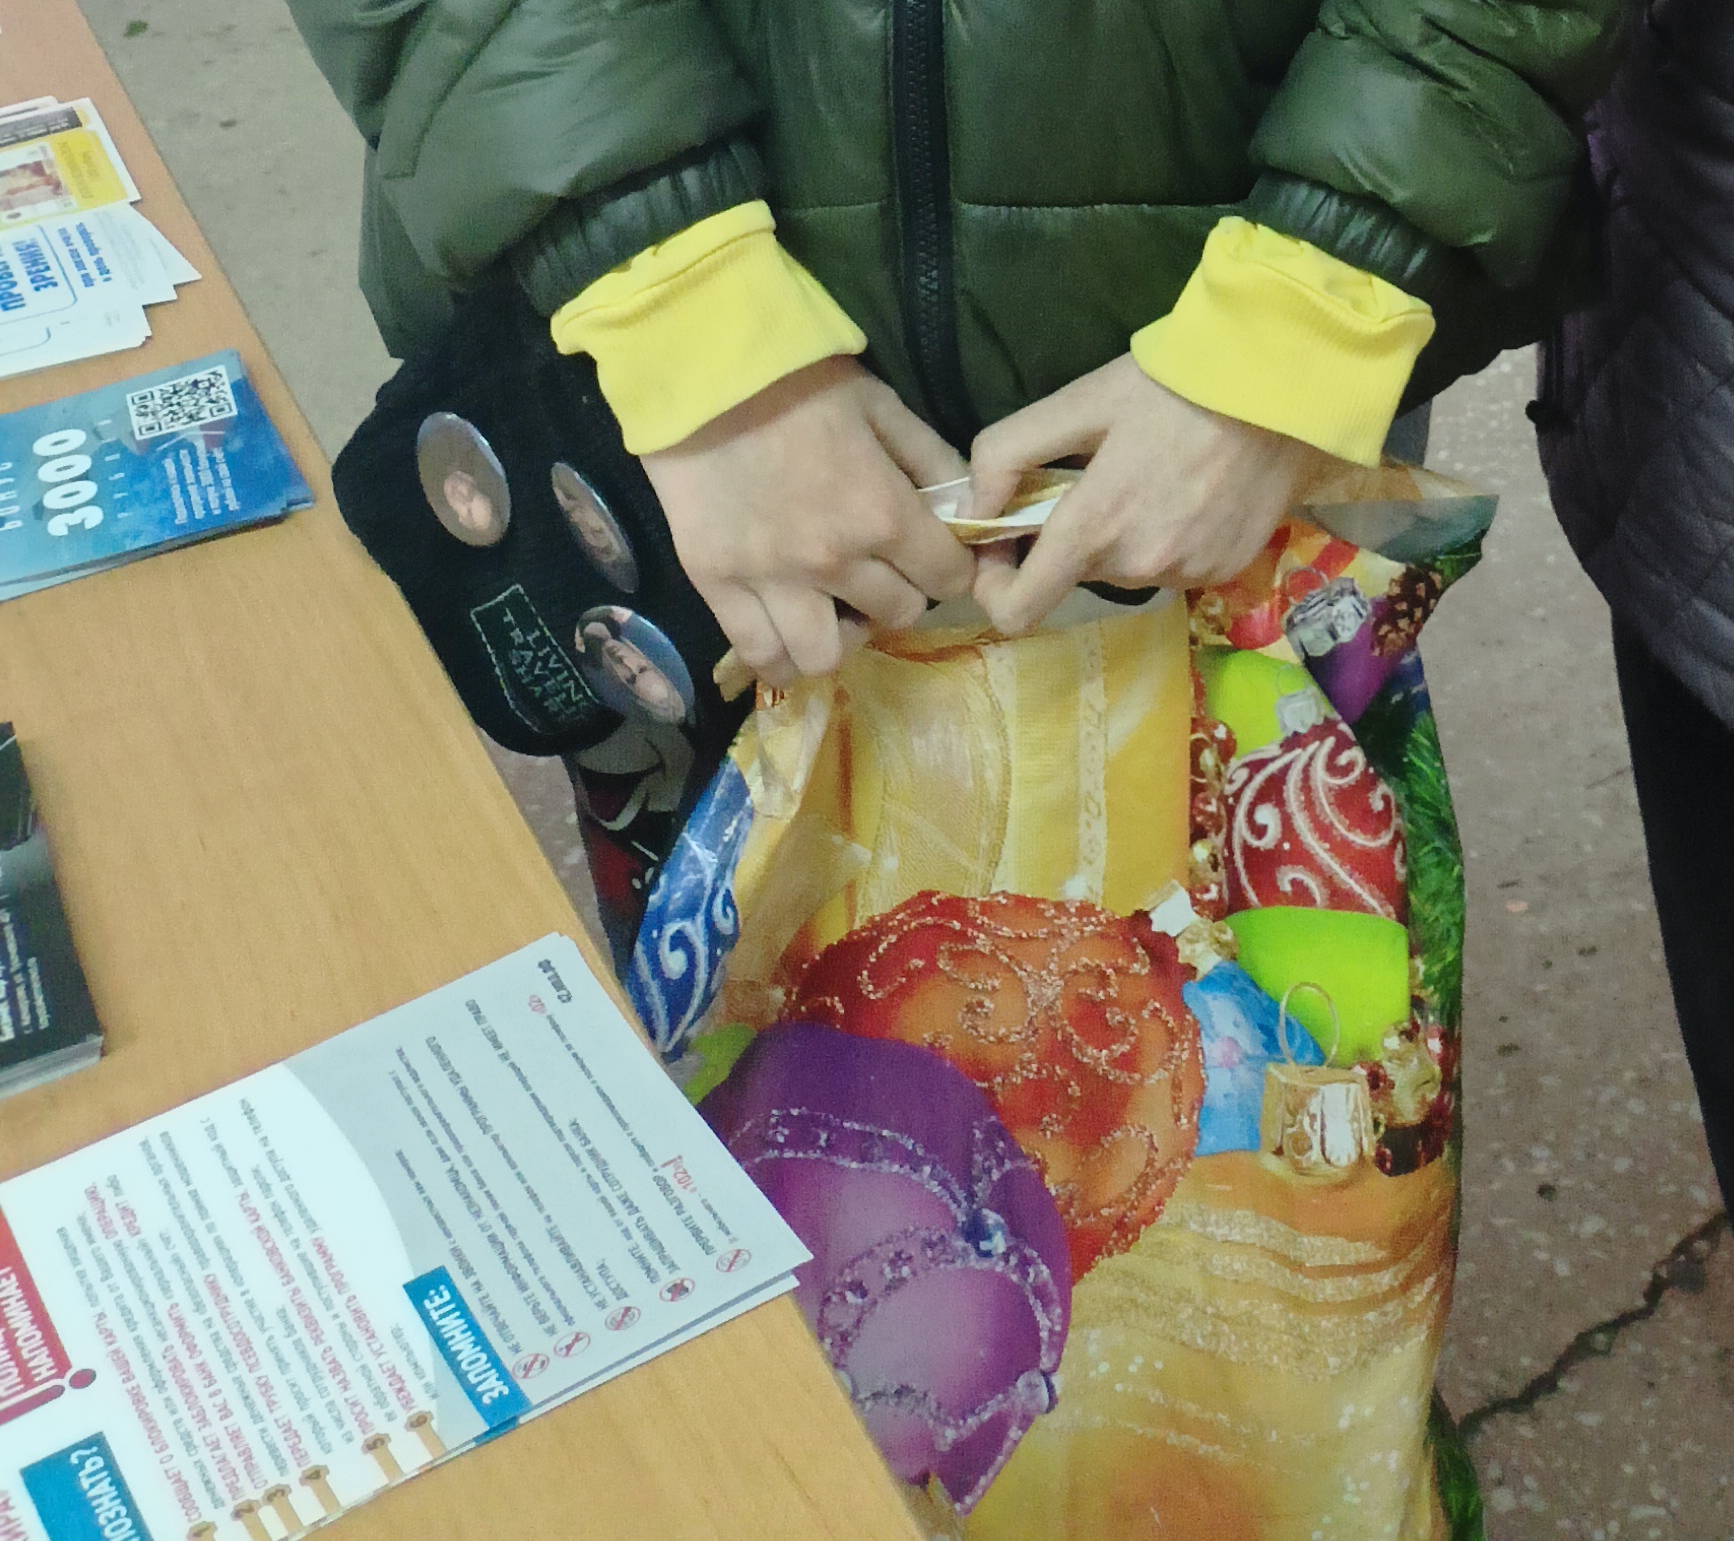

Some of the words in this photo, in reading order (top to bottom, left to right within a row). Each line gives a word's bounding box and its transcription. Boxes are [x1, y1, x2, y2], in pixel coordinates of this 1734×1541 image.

[10, 237, 59, 291] ЗРЕНИЯ!
[33, 428, 104, 536] 3000
[422, 1035, 465, 1086] УДАЛЕННОГО
[453, 1084, 496, 1135] ПРОГРАММЫ
[583, 1145, 624, 1192] СОТРУДНИК
[614, 1190, 641, 1217] ДАЖЕ
[649, 1172, 689, 1216] РАЗГОВОР
[113, 1197, 144, 1238] КРЕДИТ
[476, 1219, 492, 1233] ОТ
[679, 1213, 718, 1256] ПРЕРВИТЕ
[87, 1245, 115, 1283] Вашего
[249, 1222, 296, 1288] БАНКОВСКОЙ
[308, 1234, 352, 1295] ПРОГРАММУ
[447, 1243, 478, 1280] ЗВОНКИ
[483, 1230, 533, 1294] ИНФОРМАЦИИ
[542, 1223, 602, 1300] УСТАНАВЛИВАЙТЕ
[631, 1214, 682, 1275] ЗАПРАШИВАТЬ
[106, 1280, 120, 1293] от
[469, 1278, 486, 1294] НА
[521, 1291, 551, 1325] ВЕРЬТЕ
[594, 1296, 610, 1311] НЕ
[113, 1292, 141, 1333] кредита
[163, 1301, 203, 1361] ОФОРМИТЬ
[200, 1270, 264, 1374] ПСЕВДОСОТРУДНИКУ
[200, 1316, 215, 1331] на
[242, 1294, 274, 1335] участие
[285, 1285, 328, 1347] РЕКВИЗИТЫ
[341, 1292, 388, 1359] УСТАНОВИТЬ
[475, 1292, 517, 1344] ОТВЕЧАЙТЕ
[542, 1323, 559, 1338] НЕ
[129, 1332, 169, 1396] оформления
[208, 1329, 240, 1374] средства
[262, 1333, 293, 1376] принять
[333, 1320, 365, 1363] стороны
[418, 1282, 511, 1407] ЗАПОМНИТЕ:
[507, 1339, 524, 1355] НЕ
[104, 1345, 136, 1386] ВАШЕЙ
[159, 1342, 212, 1433] ЗАБЛОКИРОВАТЬ
[192, 1358, 217, 1389] БАНК
[289, 1335, 334, 1400] сотрудников
[317, 1344, 354, 1394] НАЗВАТЬ
[354, 1361, 392, 1412] обратной
[377, 1356, 420, 1414] УБЕЖДАЕТ
[161, 1394, 178, 1417] или
[207, 1386, 223, 1399] В
[211, 1396, 234, 1422] ВАС
[230, 1373, 265, 1426] денежные
[252, 1372, 284, 1414] ТРУБКУ
[284, 1374, 312, 1412] просит
[322, 1398, 348, 1431] числа
[343, 1391, 377, 1436] ПРОСИТ
[124, 1381, 169, 1455] БЛОКИРОВКЕ
[172, 1414, 201, 1458] средств
[272, 1411, 313, 1469] ПЕРЕДАЕТ
[301, 1410, 334, 1457] который
[339, 1429, 356, 1445] из
[158, 1452, 174, 1466] О
[201, 1429, 247, 1502] ПРЕДЛАГАЕТ
[223, 1419, 269, 1491] ОТПРАВЛЯЕТ
[256, 1424, 291, 1478] перевести
[163, 1462, 203, 1524] СООБЩАЕТ
[192, 1456, 226, 1511] денежных
